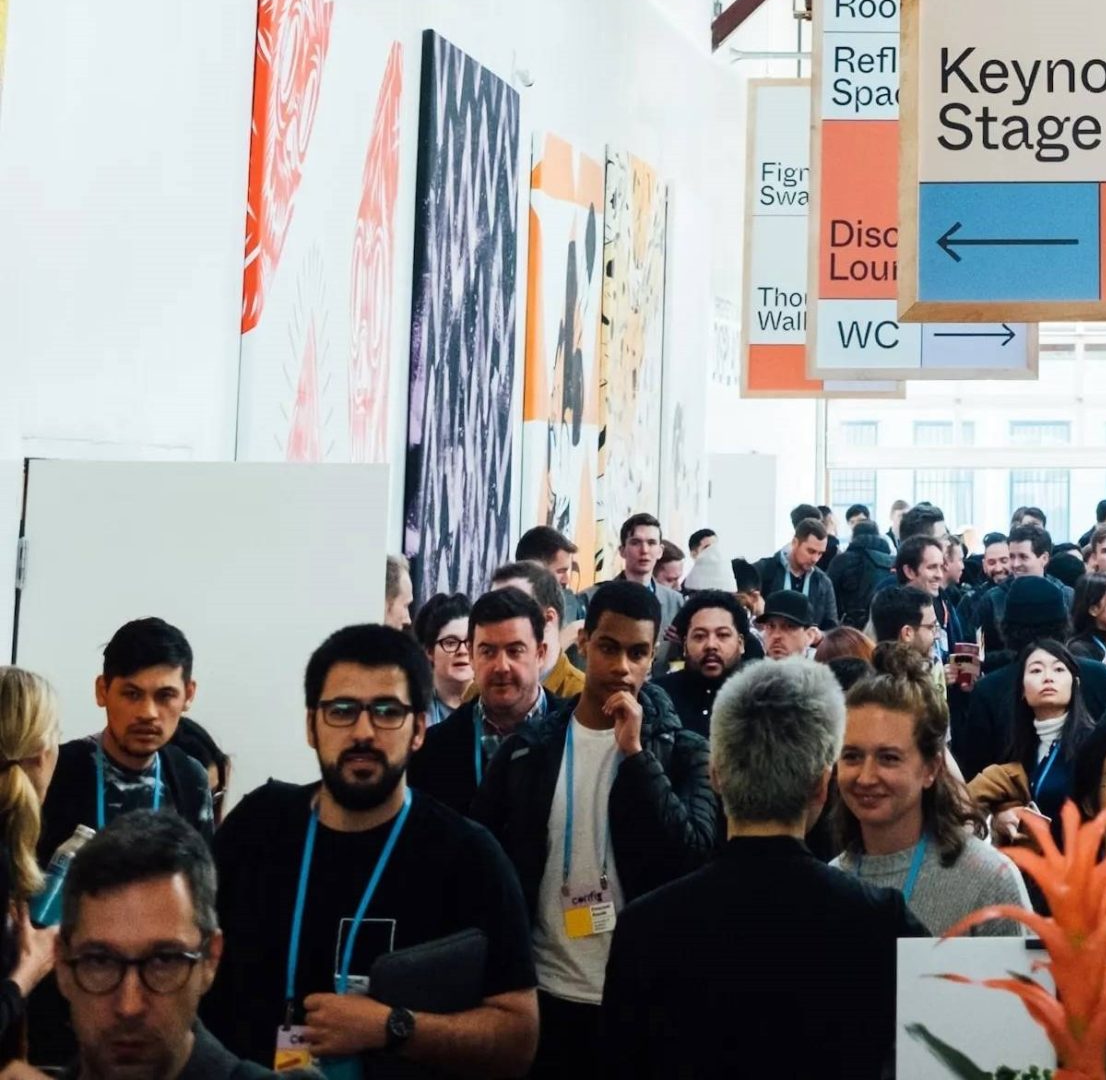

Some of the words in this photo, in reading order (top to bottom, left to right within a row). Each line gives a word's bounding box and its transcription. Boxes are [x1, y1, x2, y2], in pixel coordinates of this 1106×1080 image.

[834, 46, 897, 74] Refl
[831, 77, 900, 113] Spa
[937, 102, 1102, 163] Stage
[757, 286, 807, 308] Tho
[837, 320, 900, 350] WC
